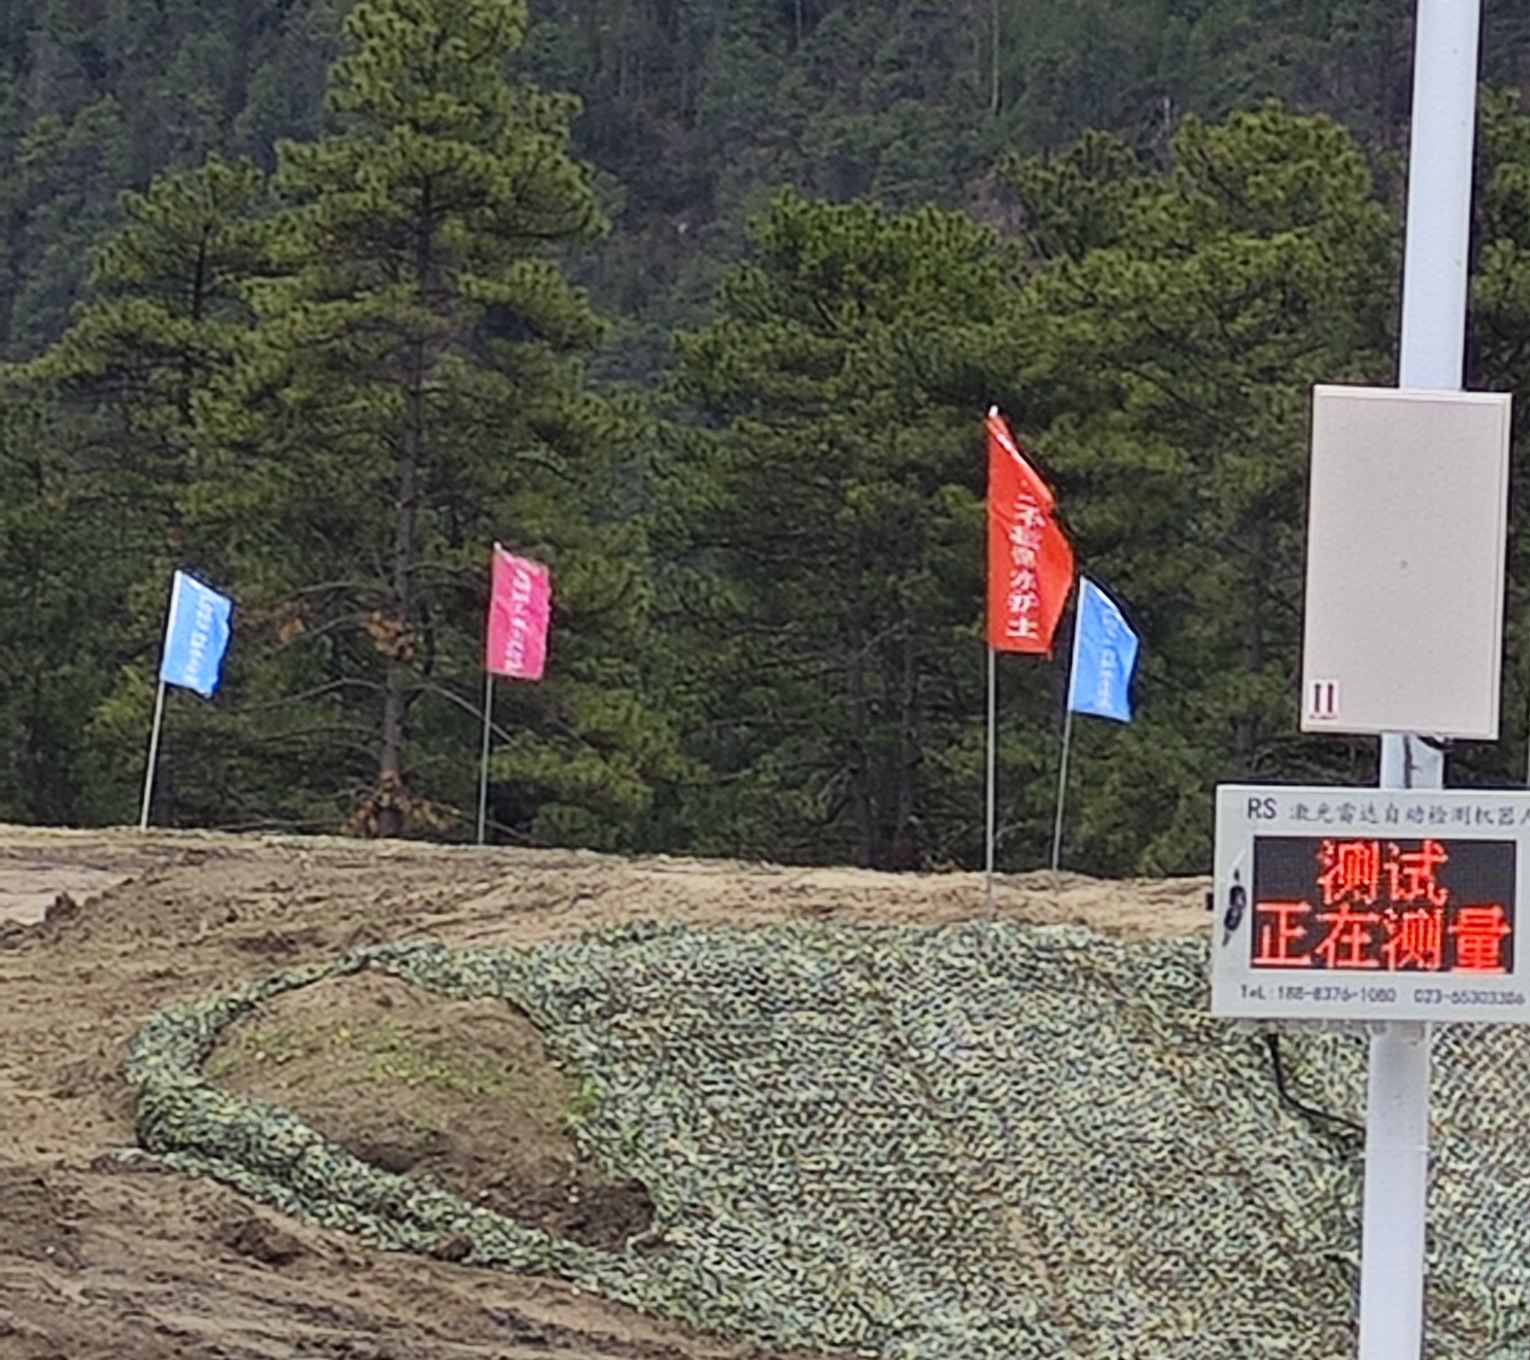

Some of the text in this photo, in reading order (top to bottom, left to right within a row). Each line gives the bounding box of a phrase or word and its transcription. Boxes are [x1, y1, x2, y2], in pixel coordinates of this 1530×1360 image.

[1247, 797, 1278, 820] RS
[1317, 839, 1450, 905] 测试
[1252, 900, 1513, 976] 正在测量
